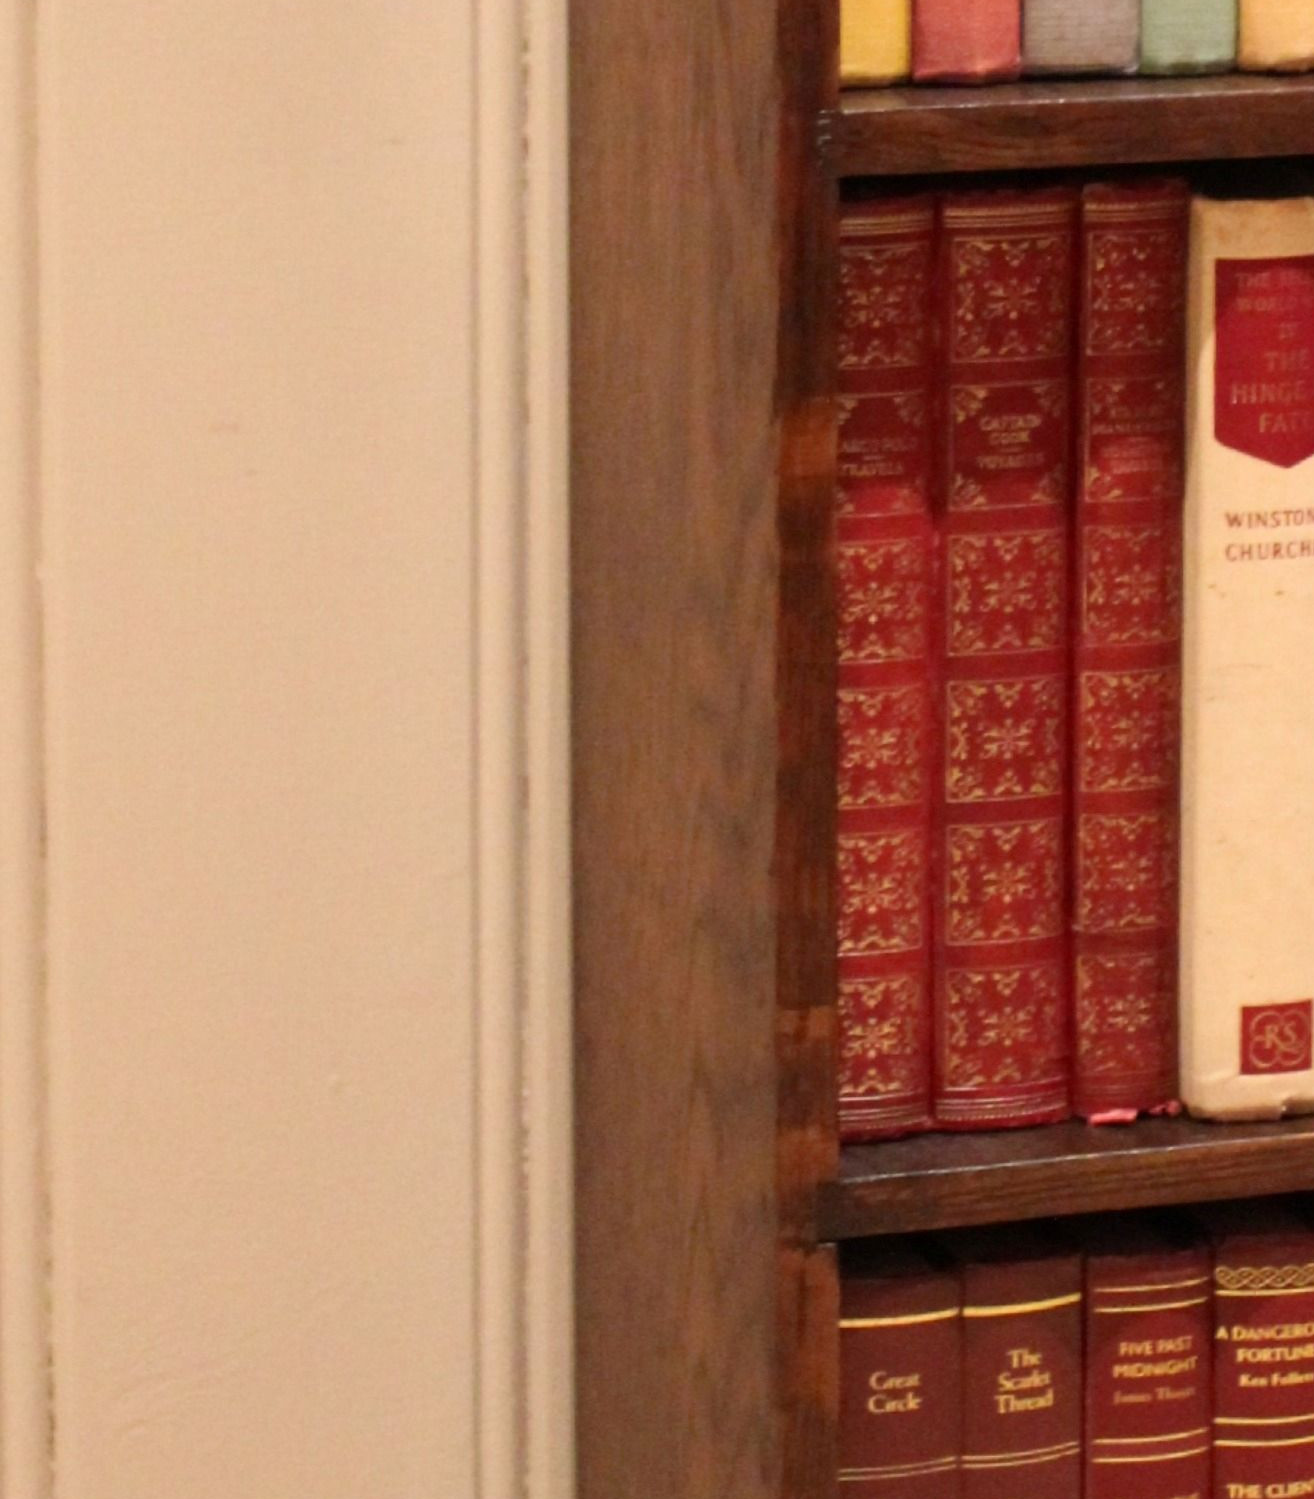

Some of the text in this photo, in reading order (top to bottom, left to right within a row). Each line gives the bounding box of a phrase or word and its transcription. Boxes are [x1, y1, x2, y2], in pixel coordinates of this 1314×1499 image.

[1216, 1326, 1228, 1340] A
[1119, 1335, 1194, 1357] FIVE PAST
[1008, 1349, 1042, 1368] The
[868, 1371, 921, 1390] Great
[998, 1370, 1051, 1391] Scarlet
[867, 1392, 923, 1414] Circle
[994, 1389, 1054, 1413] Thread
[1226, 1483, 1262, 1499] THE
